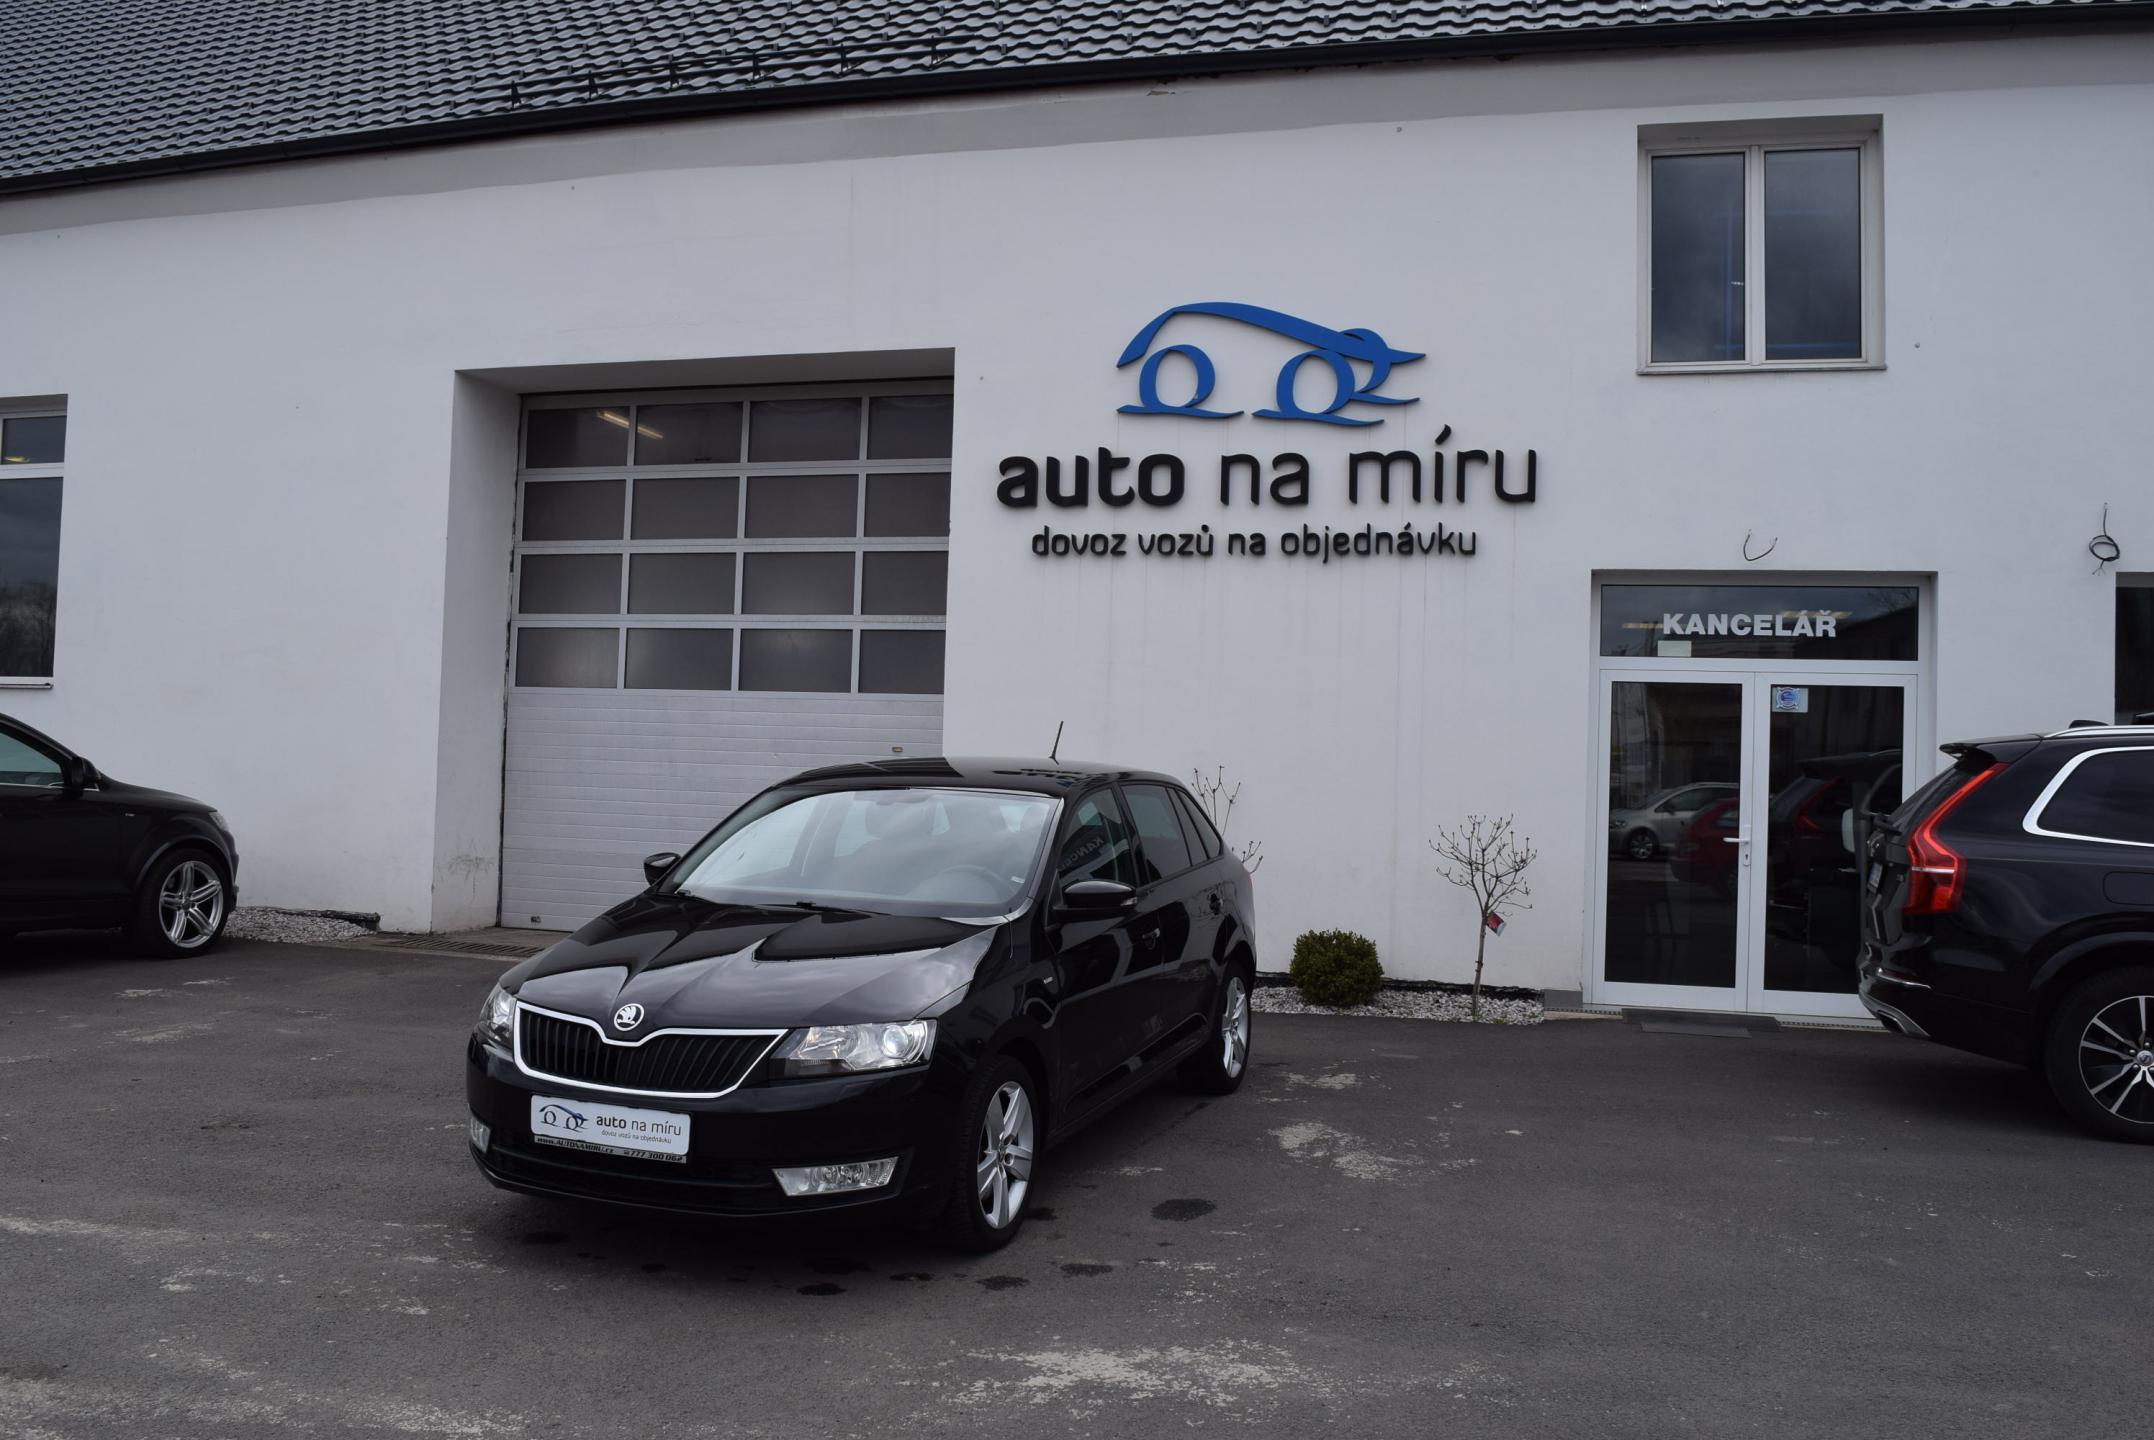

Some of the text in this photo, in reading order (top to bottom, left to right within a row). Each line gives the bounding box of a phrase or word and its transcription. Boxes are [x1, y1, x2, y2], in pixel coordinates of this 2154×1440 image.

[997, 424, 1537, 508] auto na míru
[1031, 522, 1476, 564] dovoz vozů na objednávku
[1663, 610, 1837, 637] KANCELÁŘ
[596, 1115, 681, 1136] auto na míru
[601, 1129, 617, 1138] dovoz
[631, 1150, 646, 1159] 777
